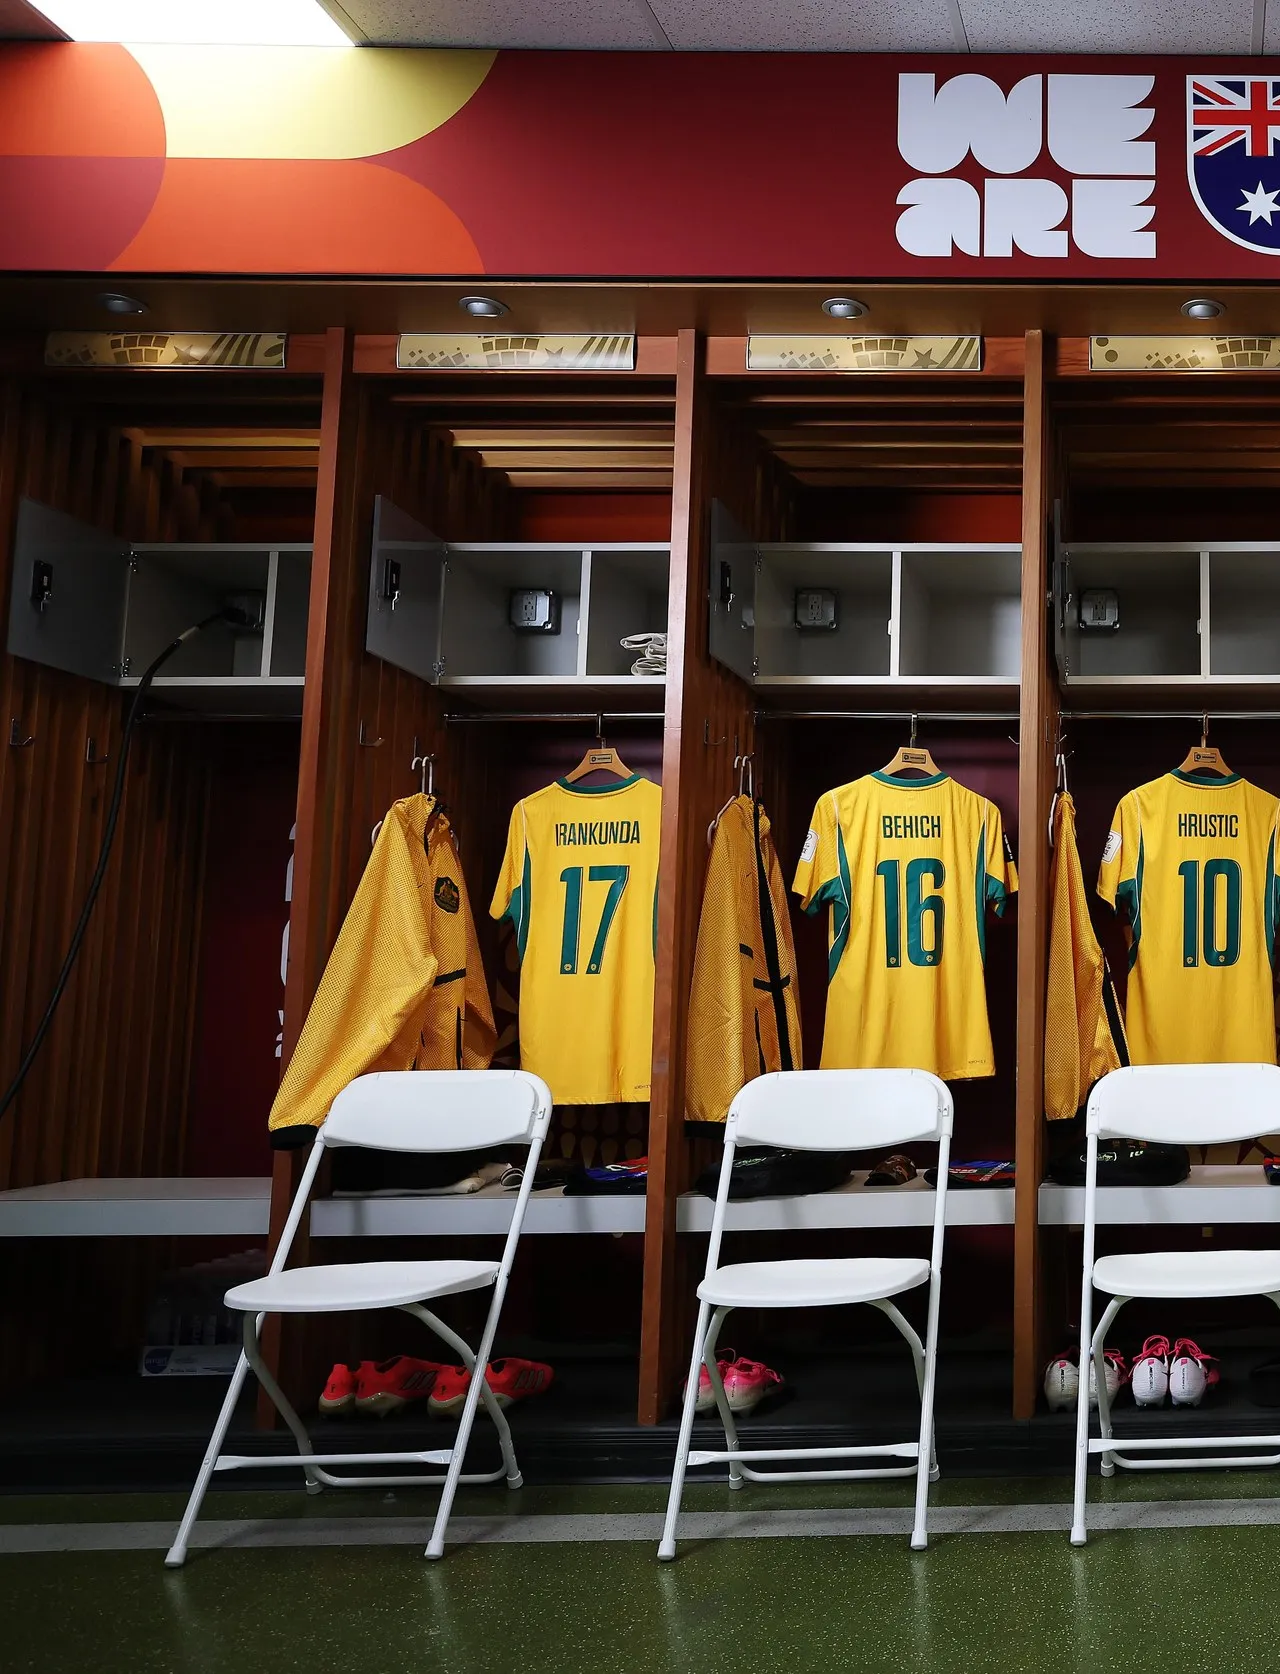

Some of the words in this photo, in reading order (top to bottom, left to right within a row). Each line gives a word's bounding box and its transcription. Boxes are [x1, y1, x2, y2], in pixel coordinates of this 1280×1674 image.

[897, 73, 1156, 175] WE
[895, 177, 1156, 258] ARE
[556, 821, 640, 847] IRANKUNDA
[882, 815, 941, 838] BEHICH
[1179, 813, 1239, 838] HRUSTIC
[560, 865, 629, 974] 17
[875, 858, 945, 967] 16
[1179, 859, 1242, 968] 10
